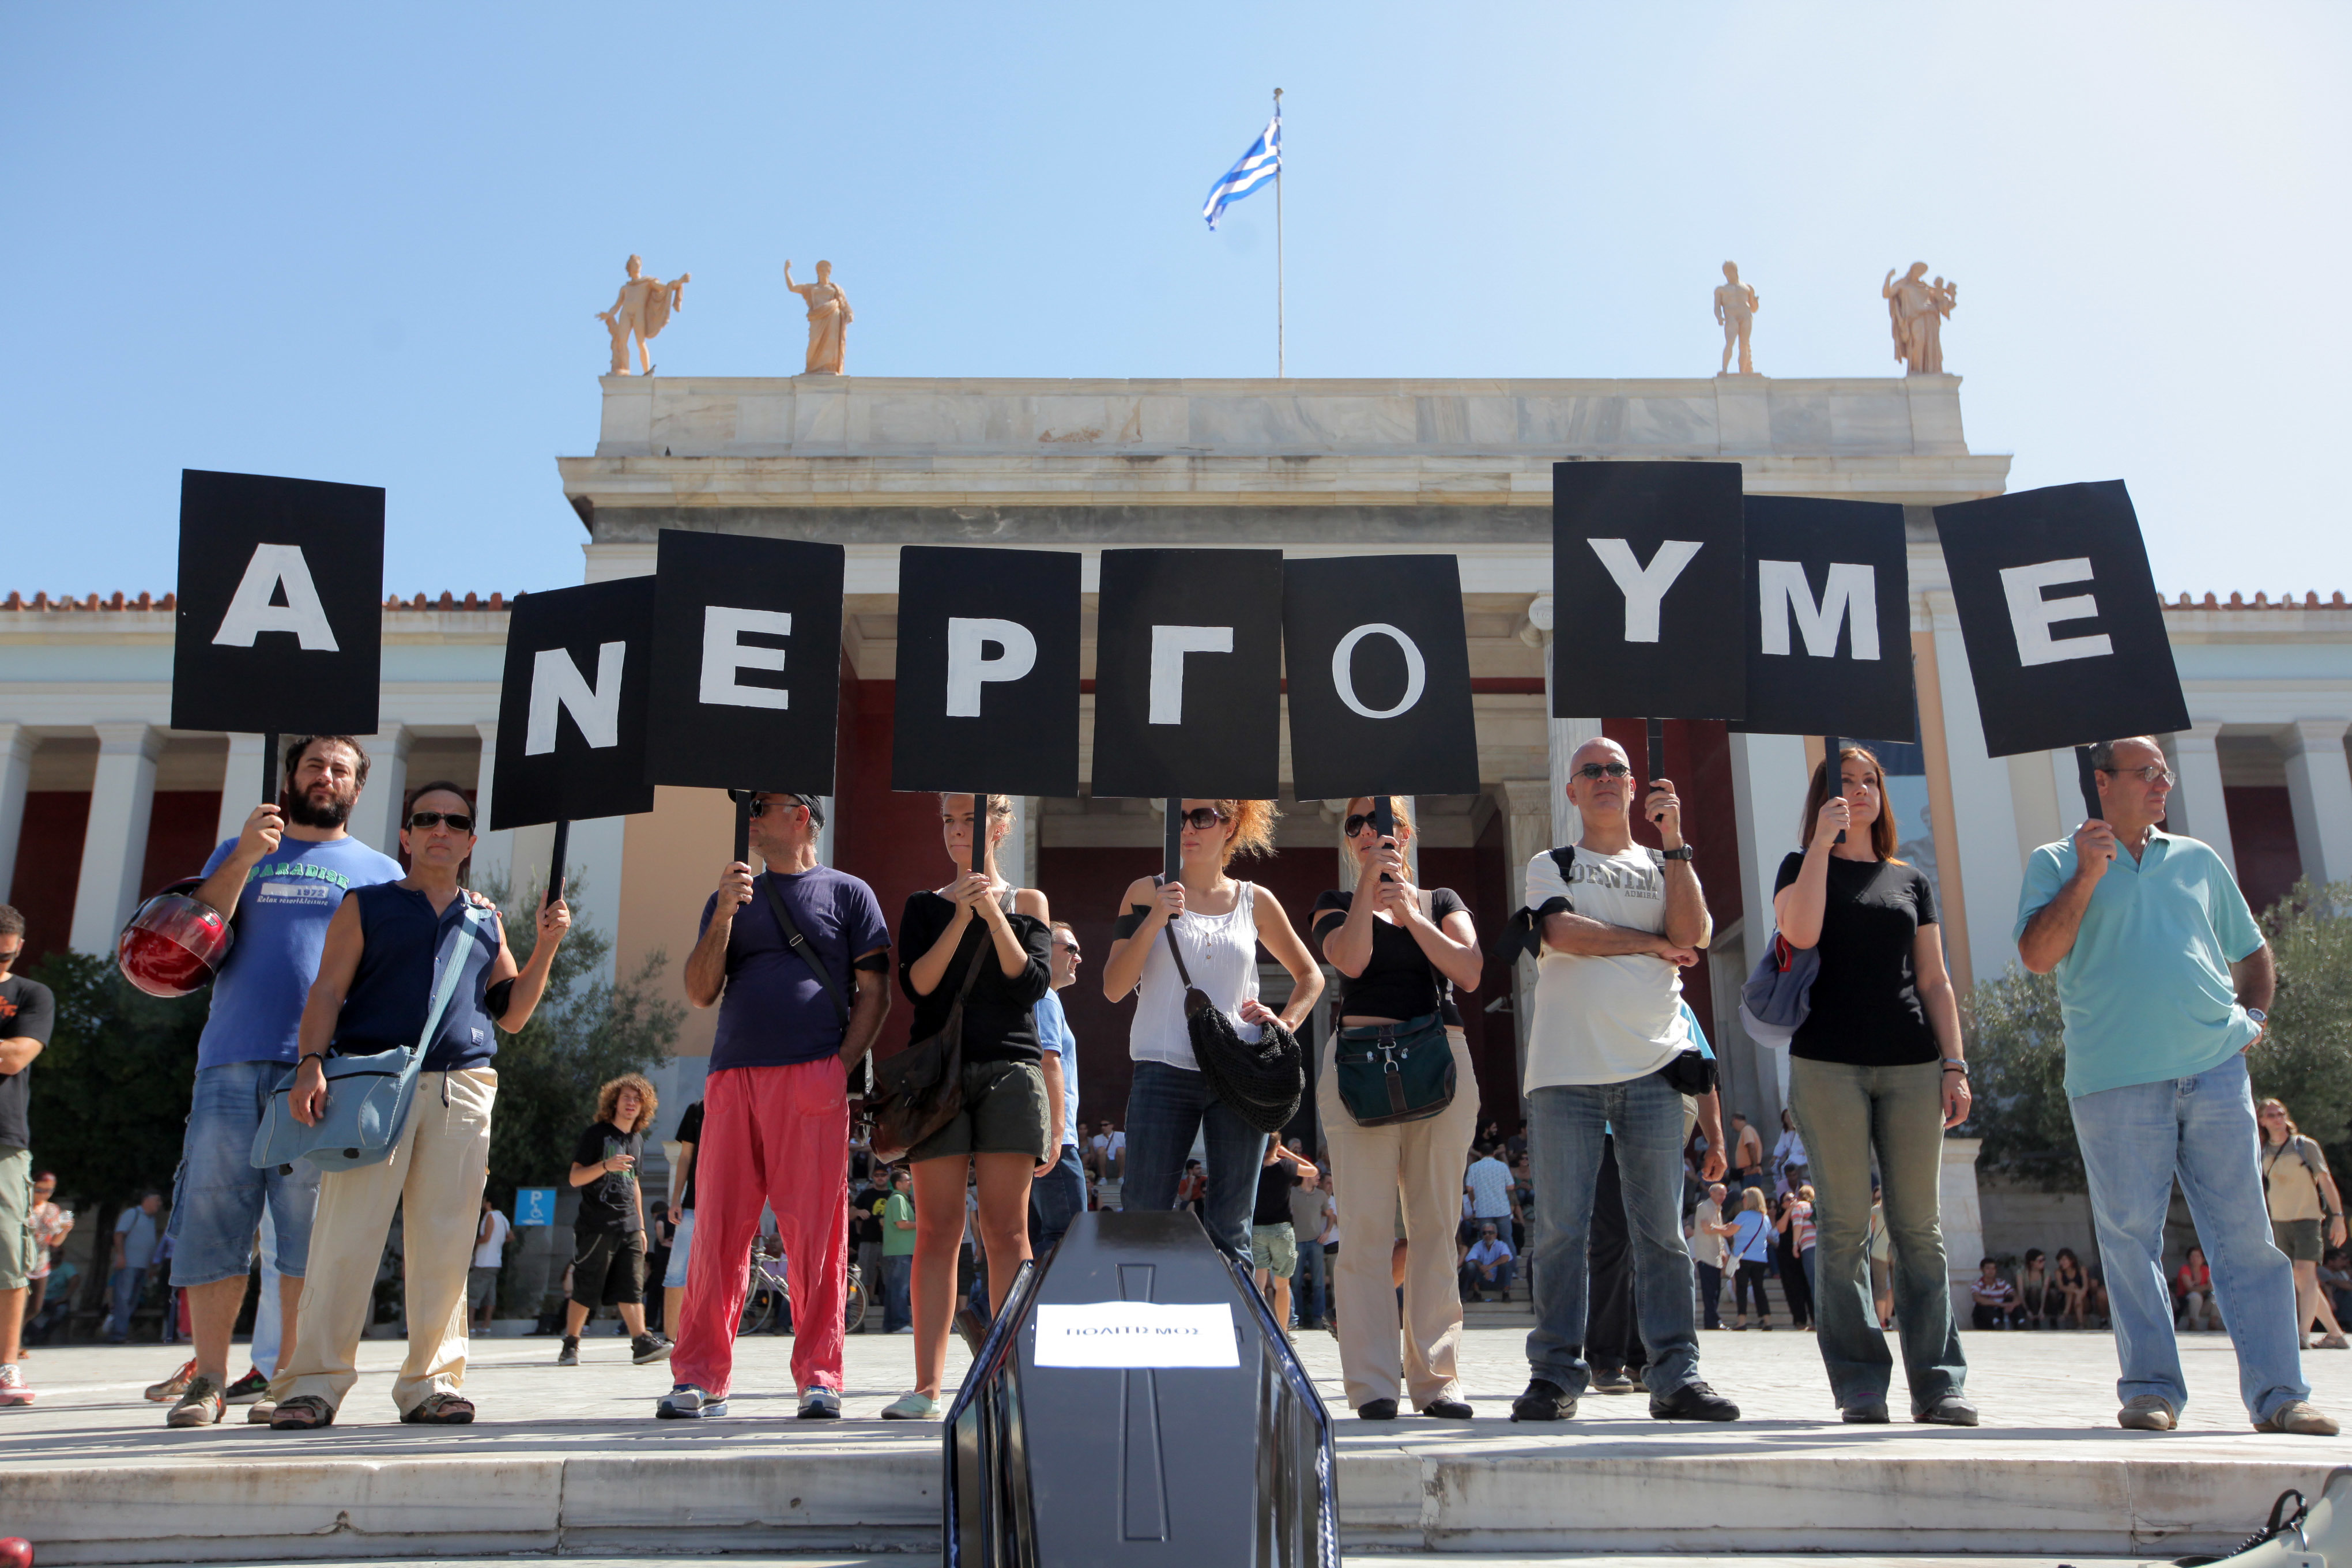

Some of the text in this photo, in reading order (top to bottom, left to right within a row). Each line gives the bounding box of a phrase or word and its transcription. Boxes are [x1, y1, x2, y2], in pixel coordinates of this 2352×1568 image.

[246, 862, 349, 890] PARADISE
[1570, 863, 1658, 892] DENIM
[257, 895, 277, 903] Relax
[1624, 889, 1660, 900] ADMIRA
[530, 1190, 543, 1205] P
